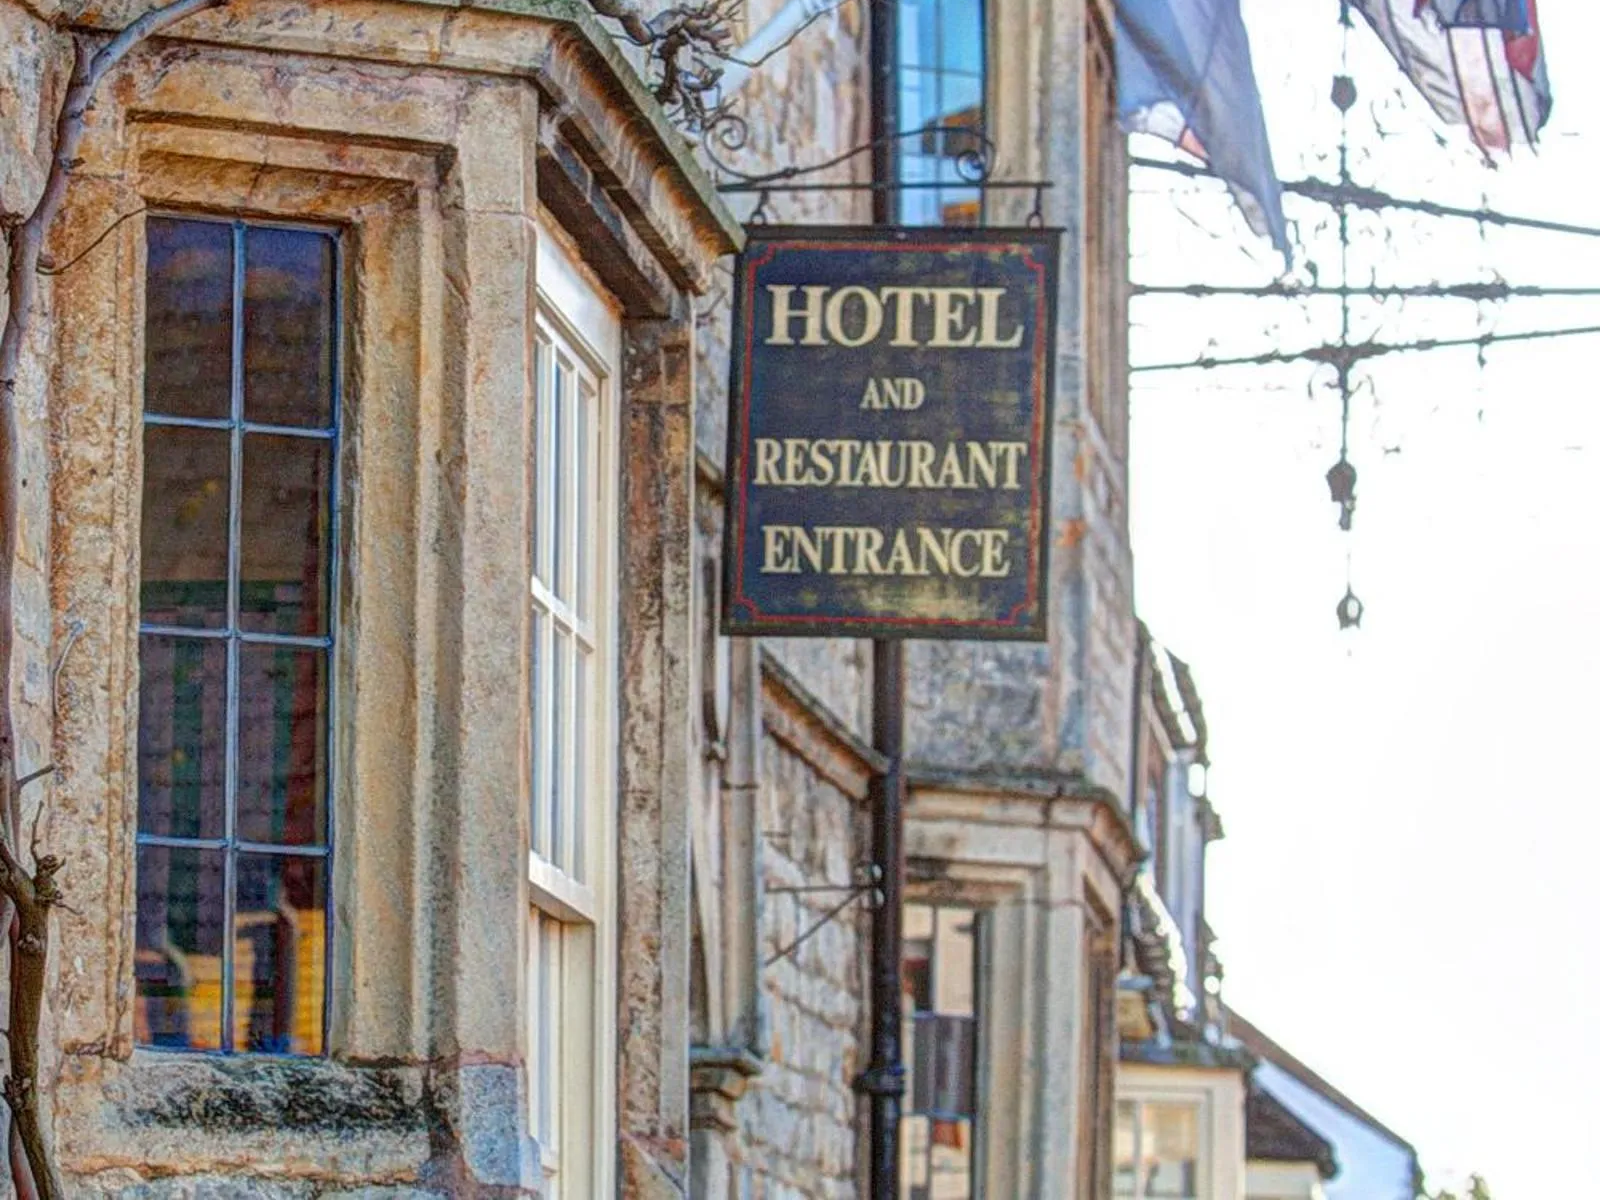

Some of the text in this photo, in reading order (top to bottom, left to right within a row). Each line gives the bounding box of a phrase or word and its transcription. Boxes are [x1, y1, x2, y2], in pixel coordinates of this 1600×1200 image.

[764, 284, 1025, 349] HOTEL
[859, 377, 926, 411] AND
[752, 437, 1028, 490] RESTAURANT
[759, 524, 1011, 578] ENTRANCE
